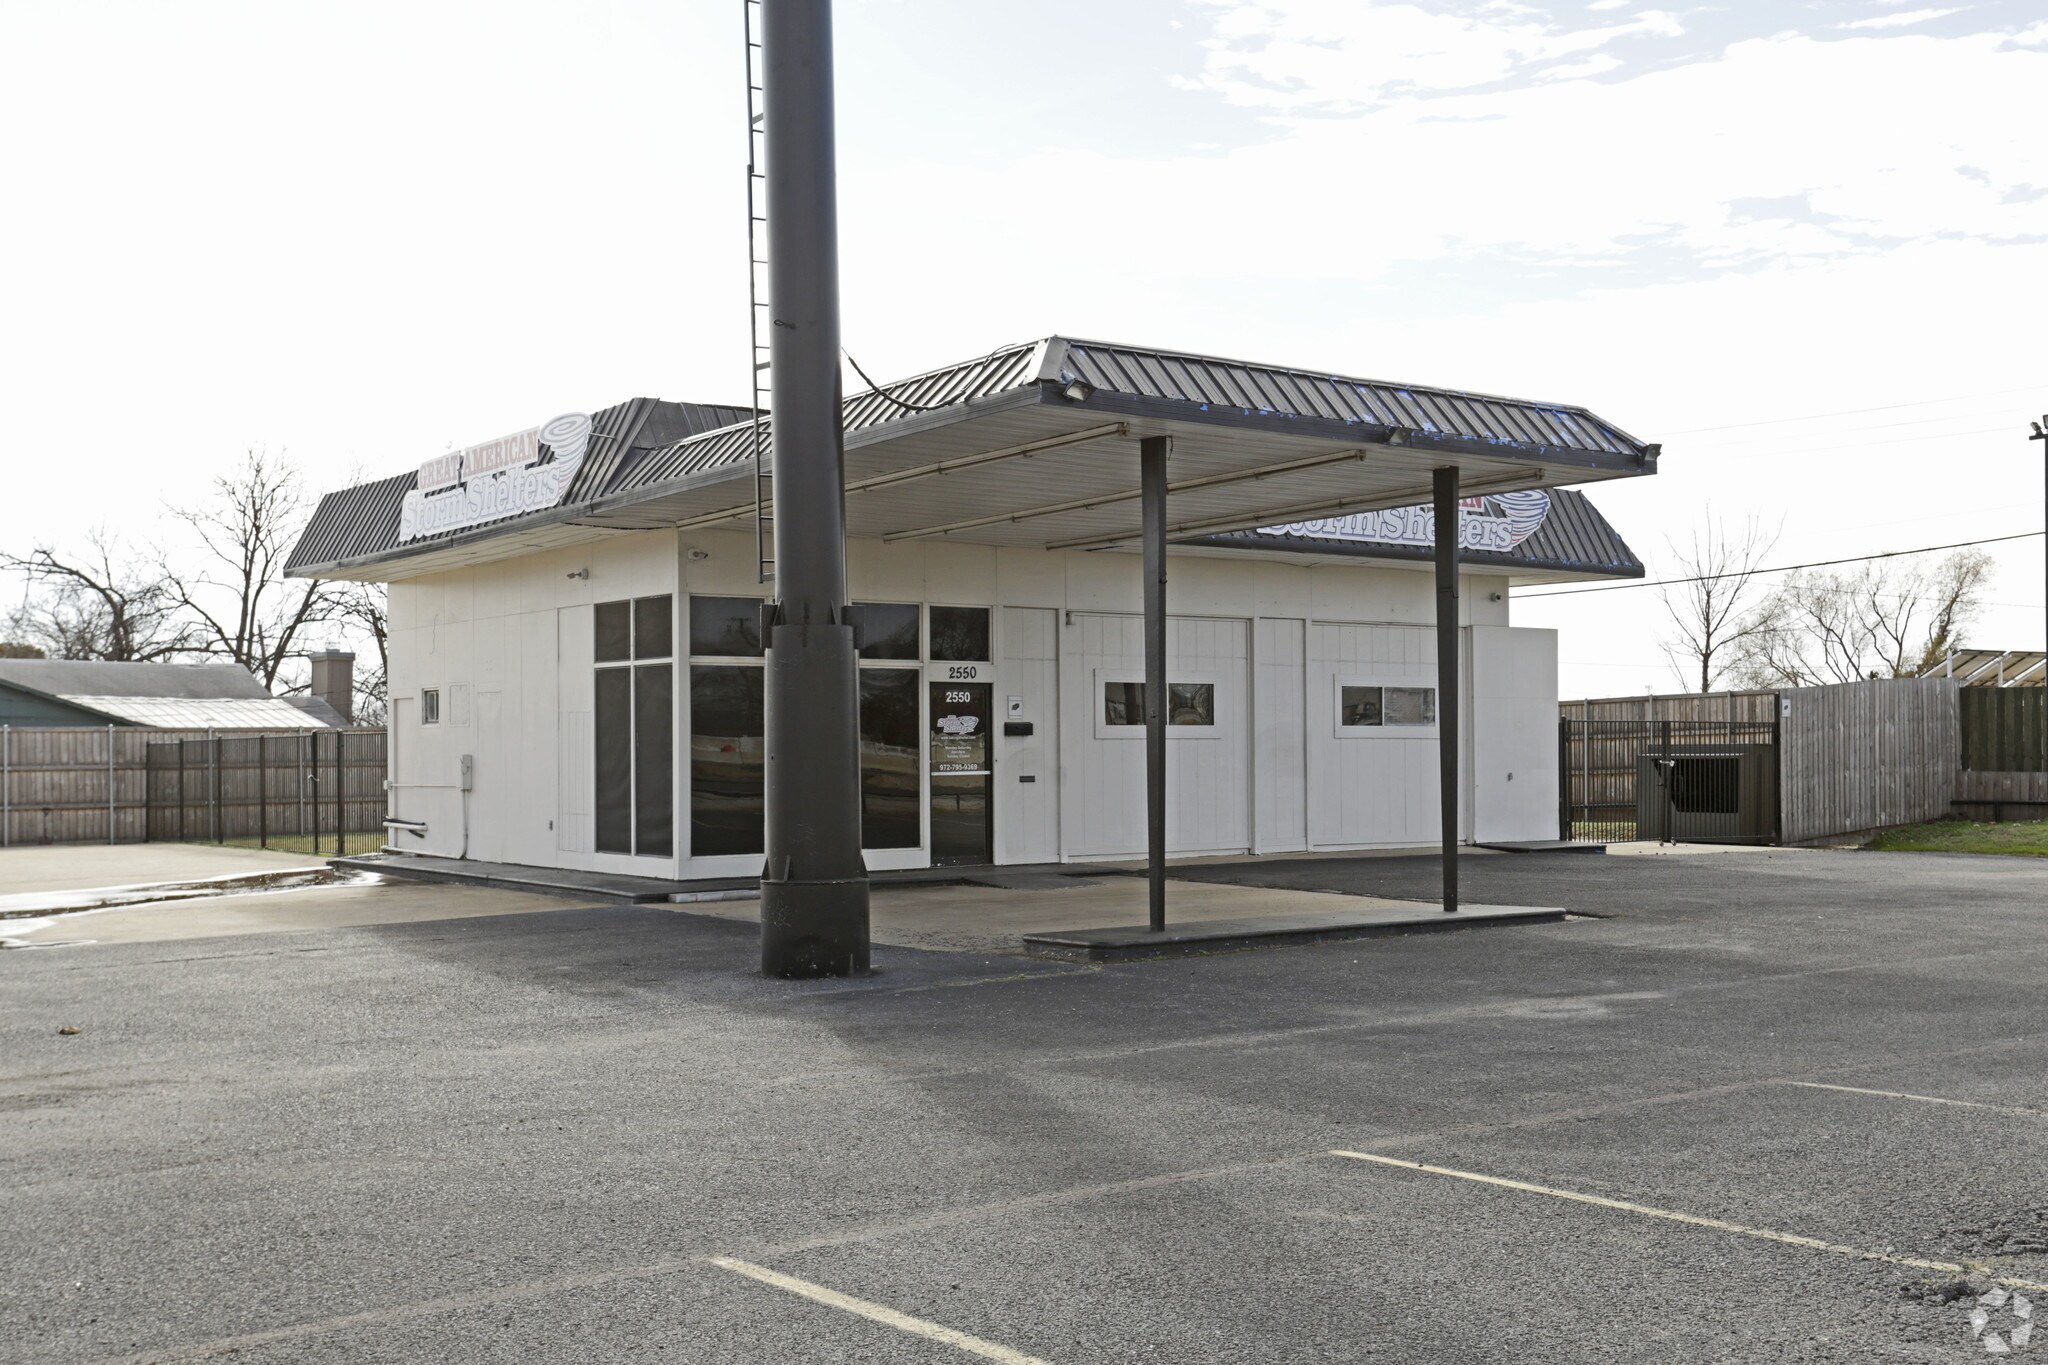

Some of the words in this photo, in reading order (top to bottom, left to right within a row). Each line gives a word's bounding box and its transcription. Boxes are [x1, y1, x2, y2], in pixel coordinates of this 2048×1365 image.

[419, 452, 458, 489] GREAT
[462, 430, 539, 478] AMERICAN
[402, 493, 465, 536] Storm
[466, 467, 560, 521] Shelters
[1380, 506, 1513, 547] Sheters
[949, 666, 977, 679] 2550
[945, 691, 971, 703] 2550
